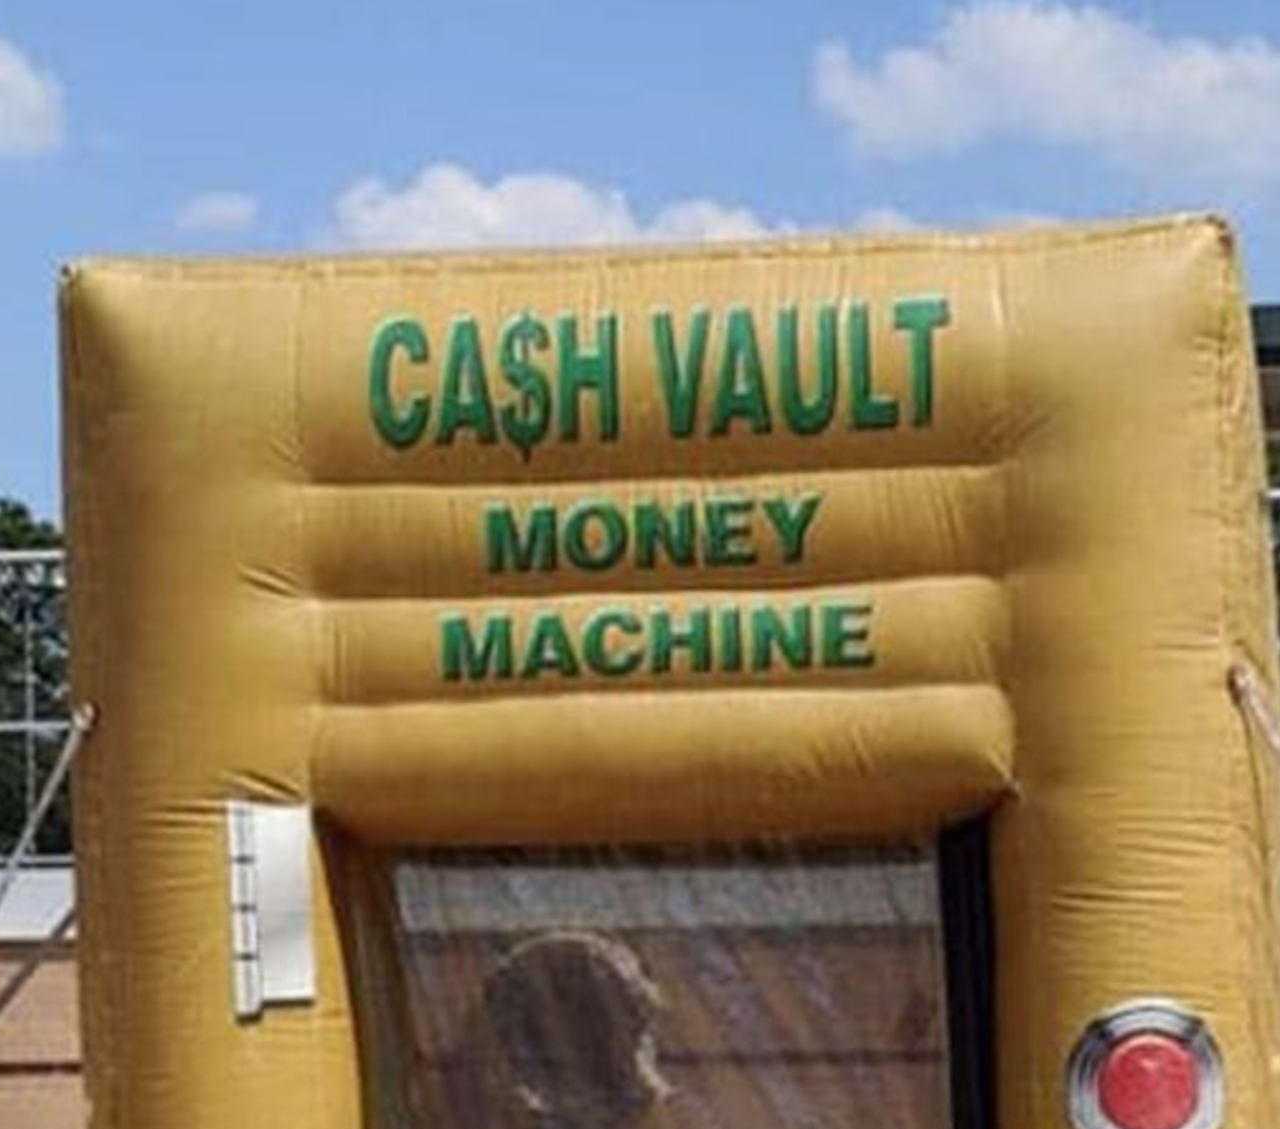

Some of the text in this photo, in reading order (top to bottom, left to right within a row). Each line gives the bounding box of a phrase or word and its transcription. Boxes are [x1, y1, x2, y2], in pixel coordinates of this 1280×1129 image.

[368, 297, 950, 462] CA$H VAULT
[485, 496, 823, 574] MONEY
[440, 605, 875, 681] MACHINE
